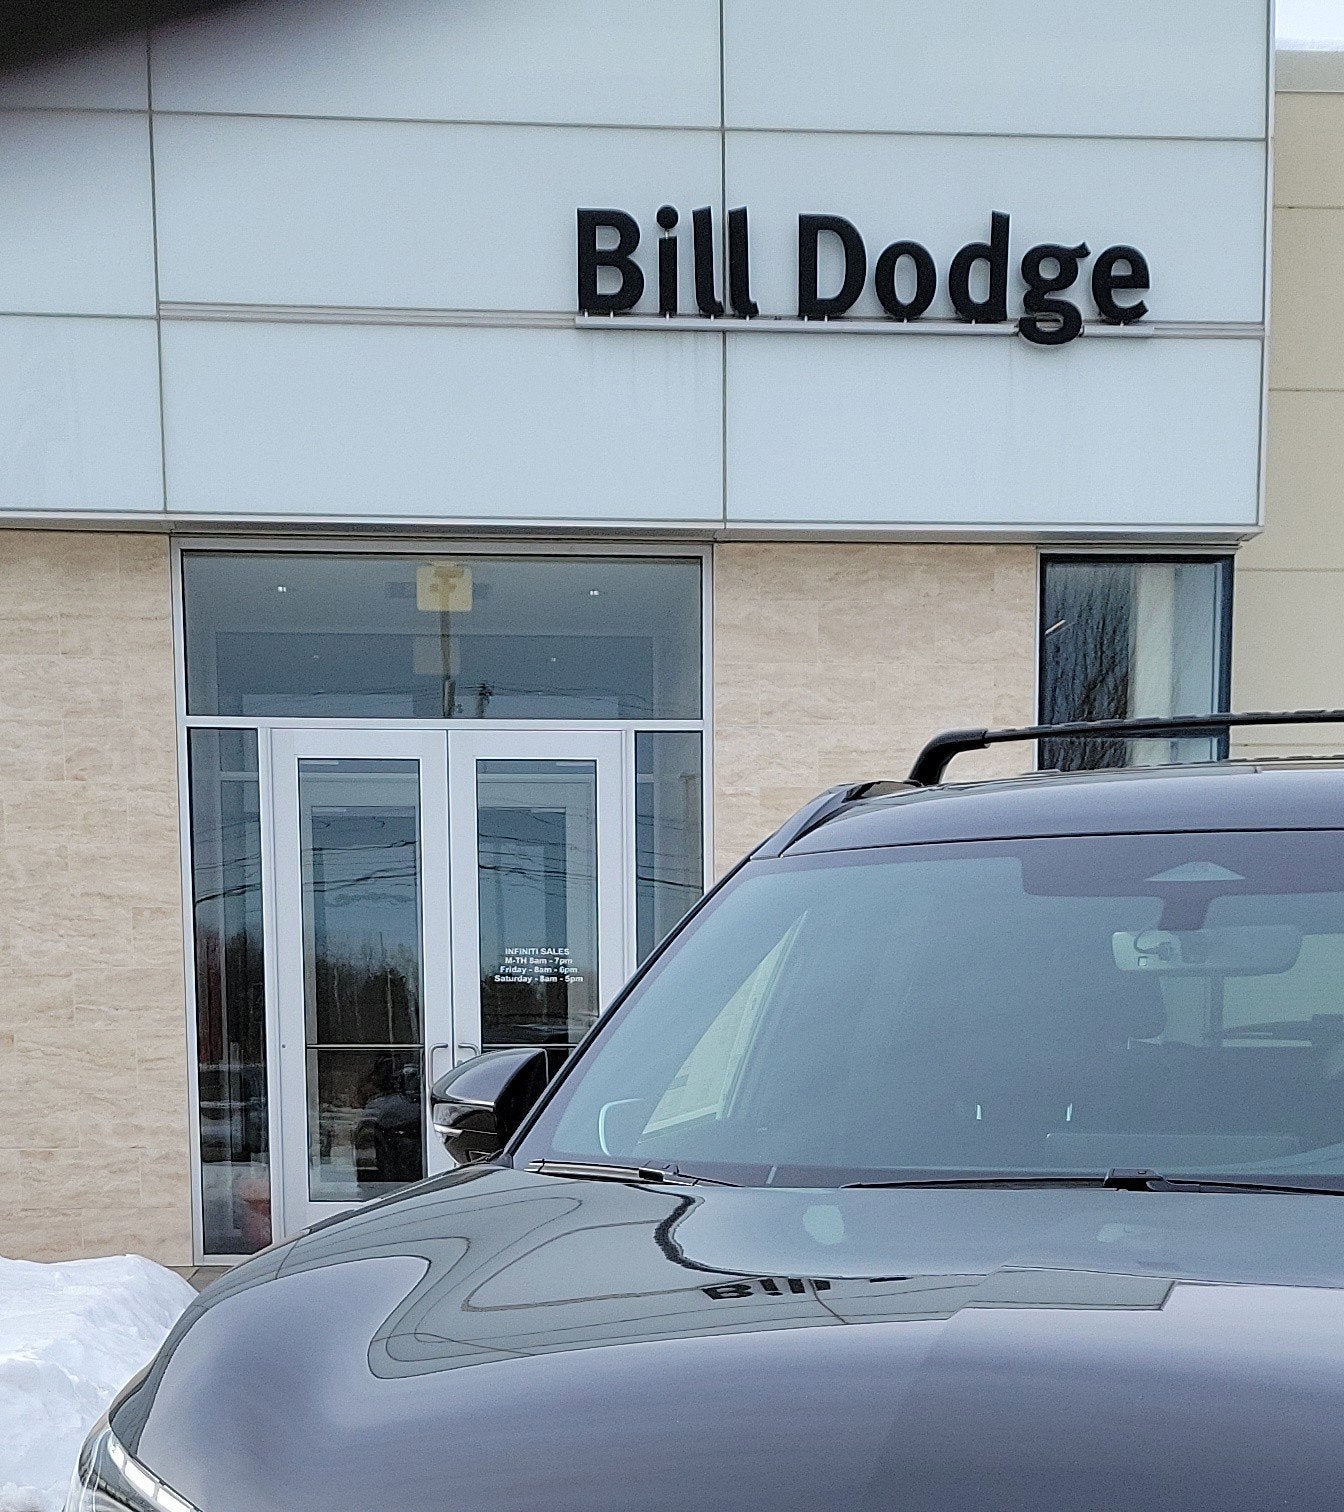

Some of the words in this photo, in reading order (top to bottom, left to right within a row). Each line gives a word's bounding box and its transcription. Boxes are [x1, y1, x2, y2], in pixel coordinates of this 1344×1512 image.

[576, 205, 758, 316] Bill
[799, 210, 1151, 346] Dodge
[554, 957, 573, 965] 7pm
[500, 966, 527, 974] Friday
[494, 975, 533, 983] Saturday
[564, 975, 584, 983] 5pm
